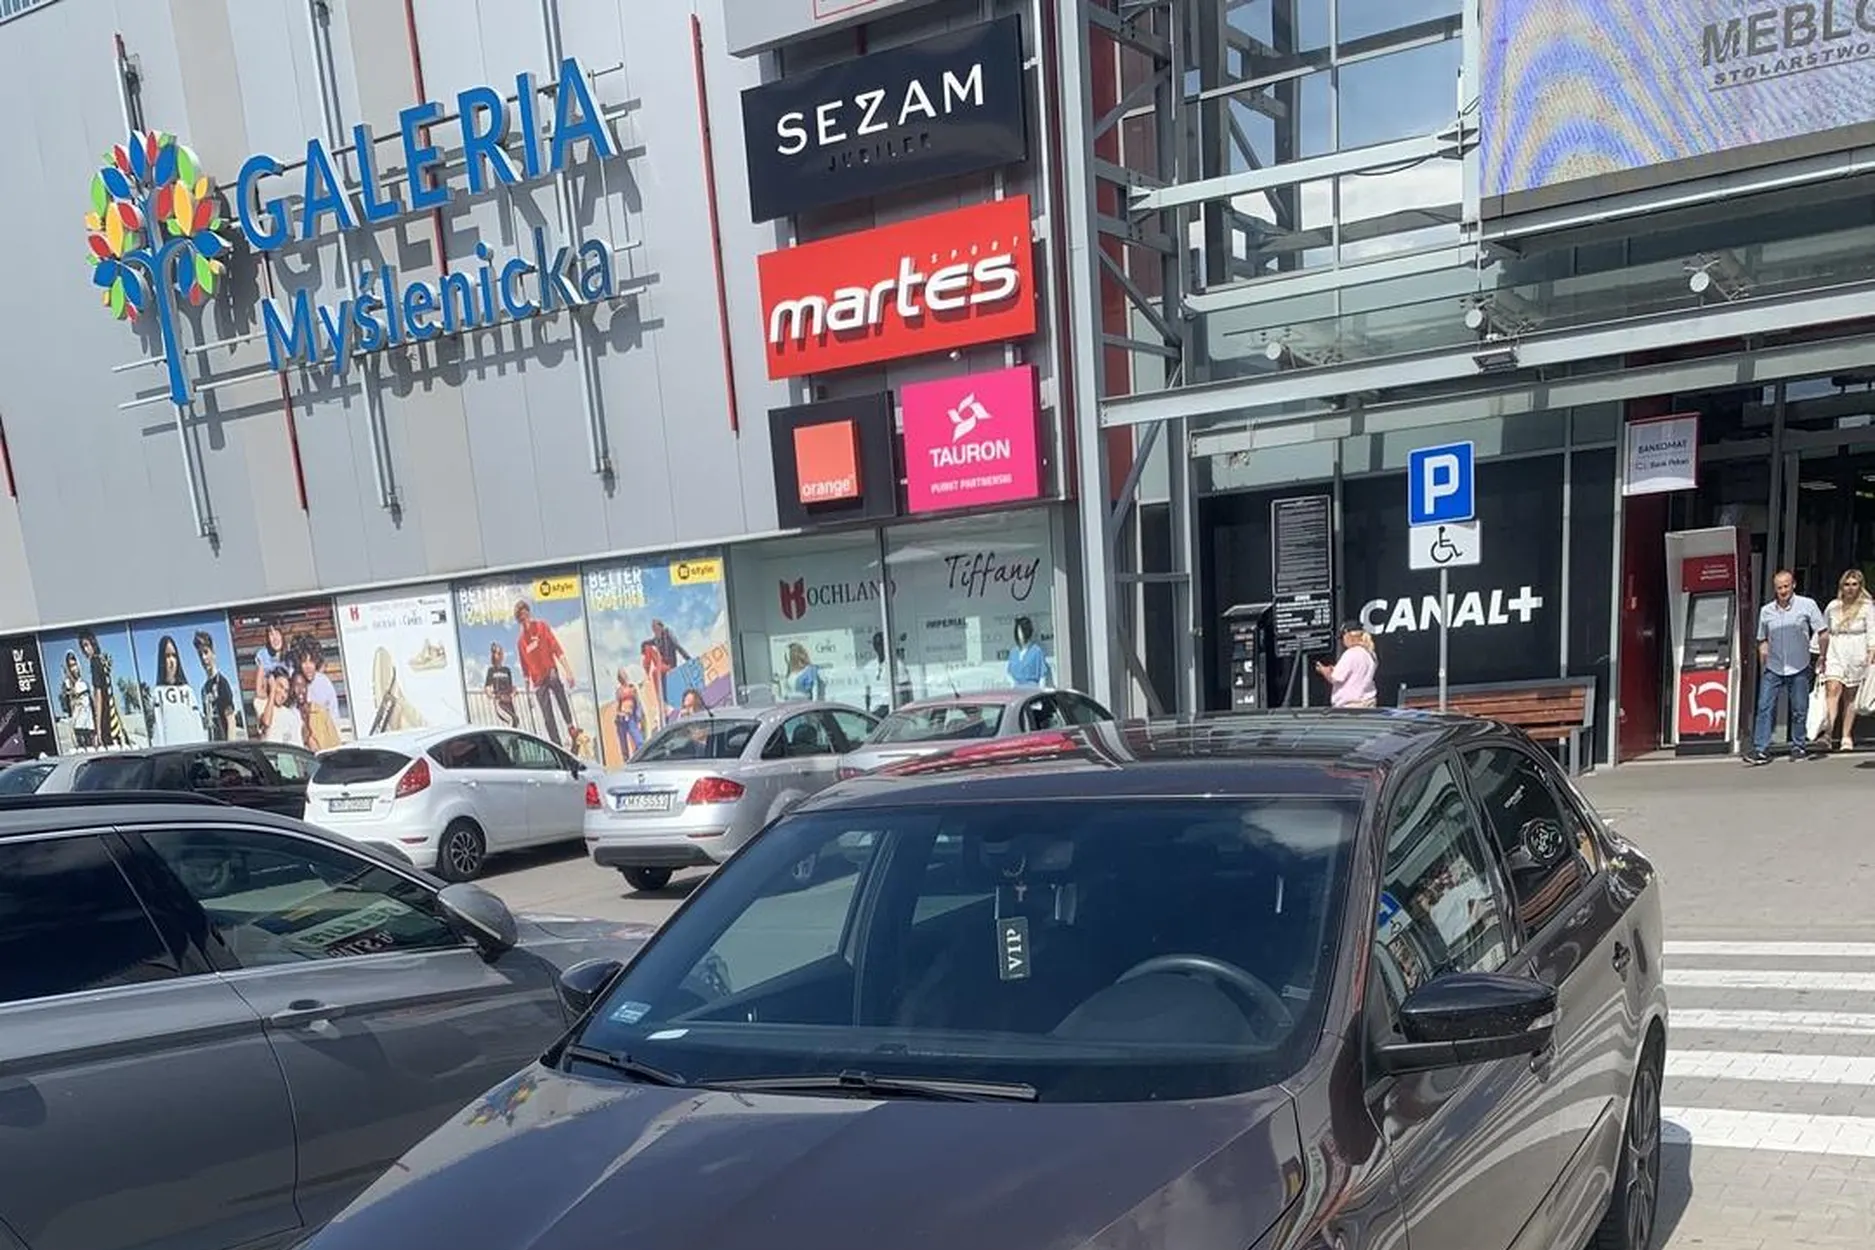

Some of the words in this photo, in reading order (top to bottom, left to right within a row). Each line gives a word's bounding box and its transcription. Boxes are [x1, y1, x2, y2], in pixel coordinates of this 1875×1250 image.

[1714, 42, 1871, 85] STOLARSTWO
[777, 64, 984, 156] SEZAM
[236, 57, 617, 252] GALERIA
[828, 133, 931, 171] JUBILER
[261, 227, 614, 374] Myślenicka
[769, 253, 1020, 345] martes
[929, 438, 1011, 468] TAURON
[803, 480, 850, 497] orange
[1423, 453, 1460, 515] P
[944, 551, 1040, 601] Tiffany
[1359, 586, 1543, 635] CANAL+
[1006, 928, 1022, 971] VIP
